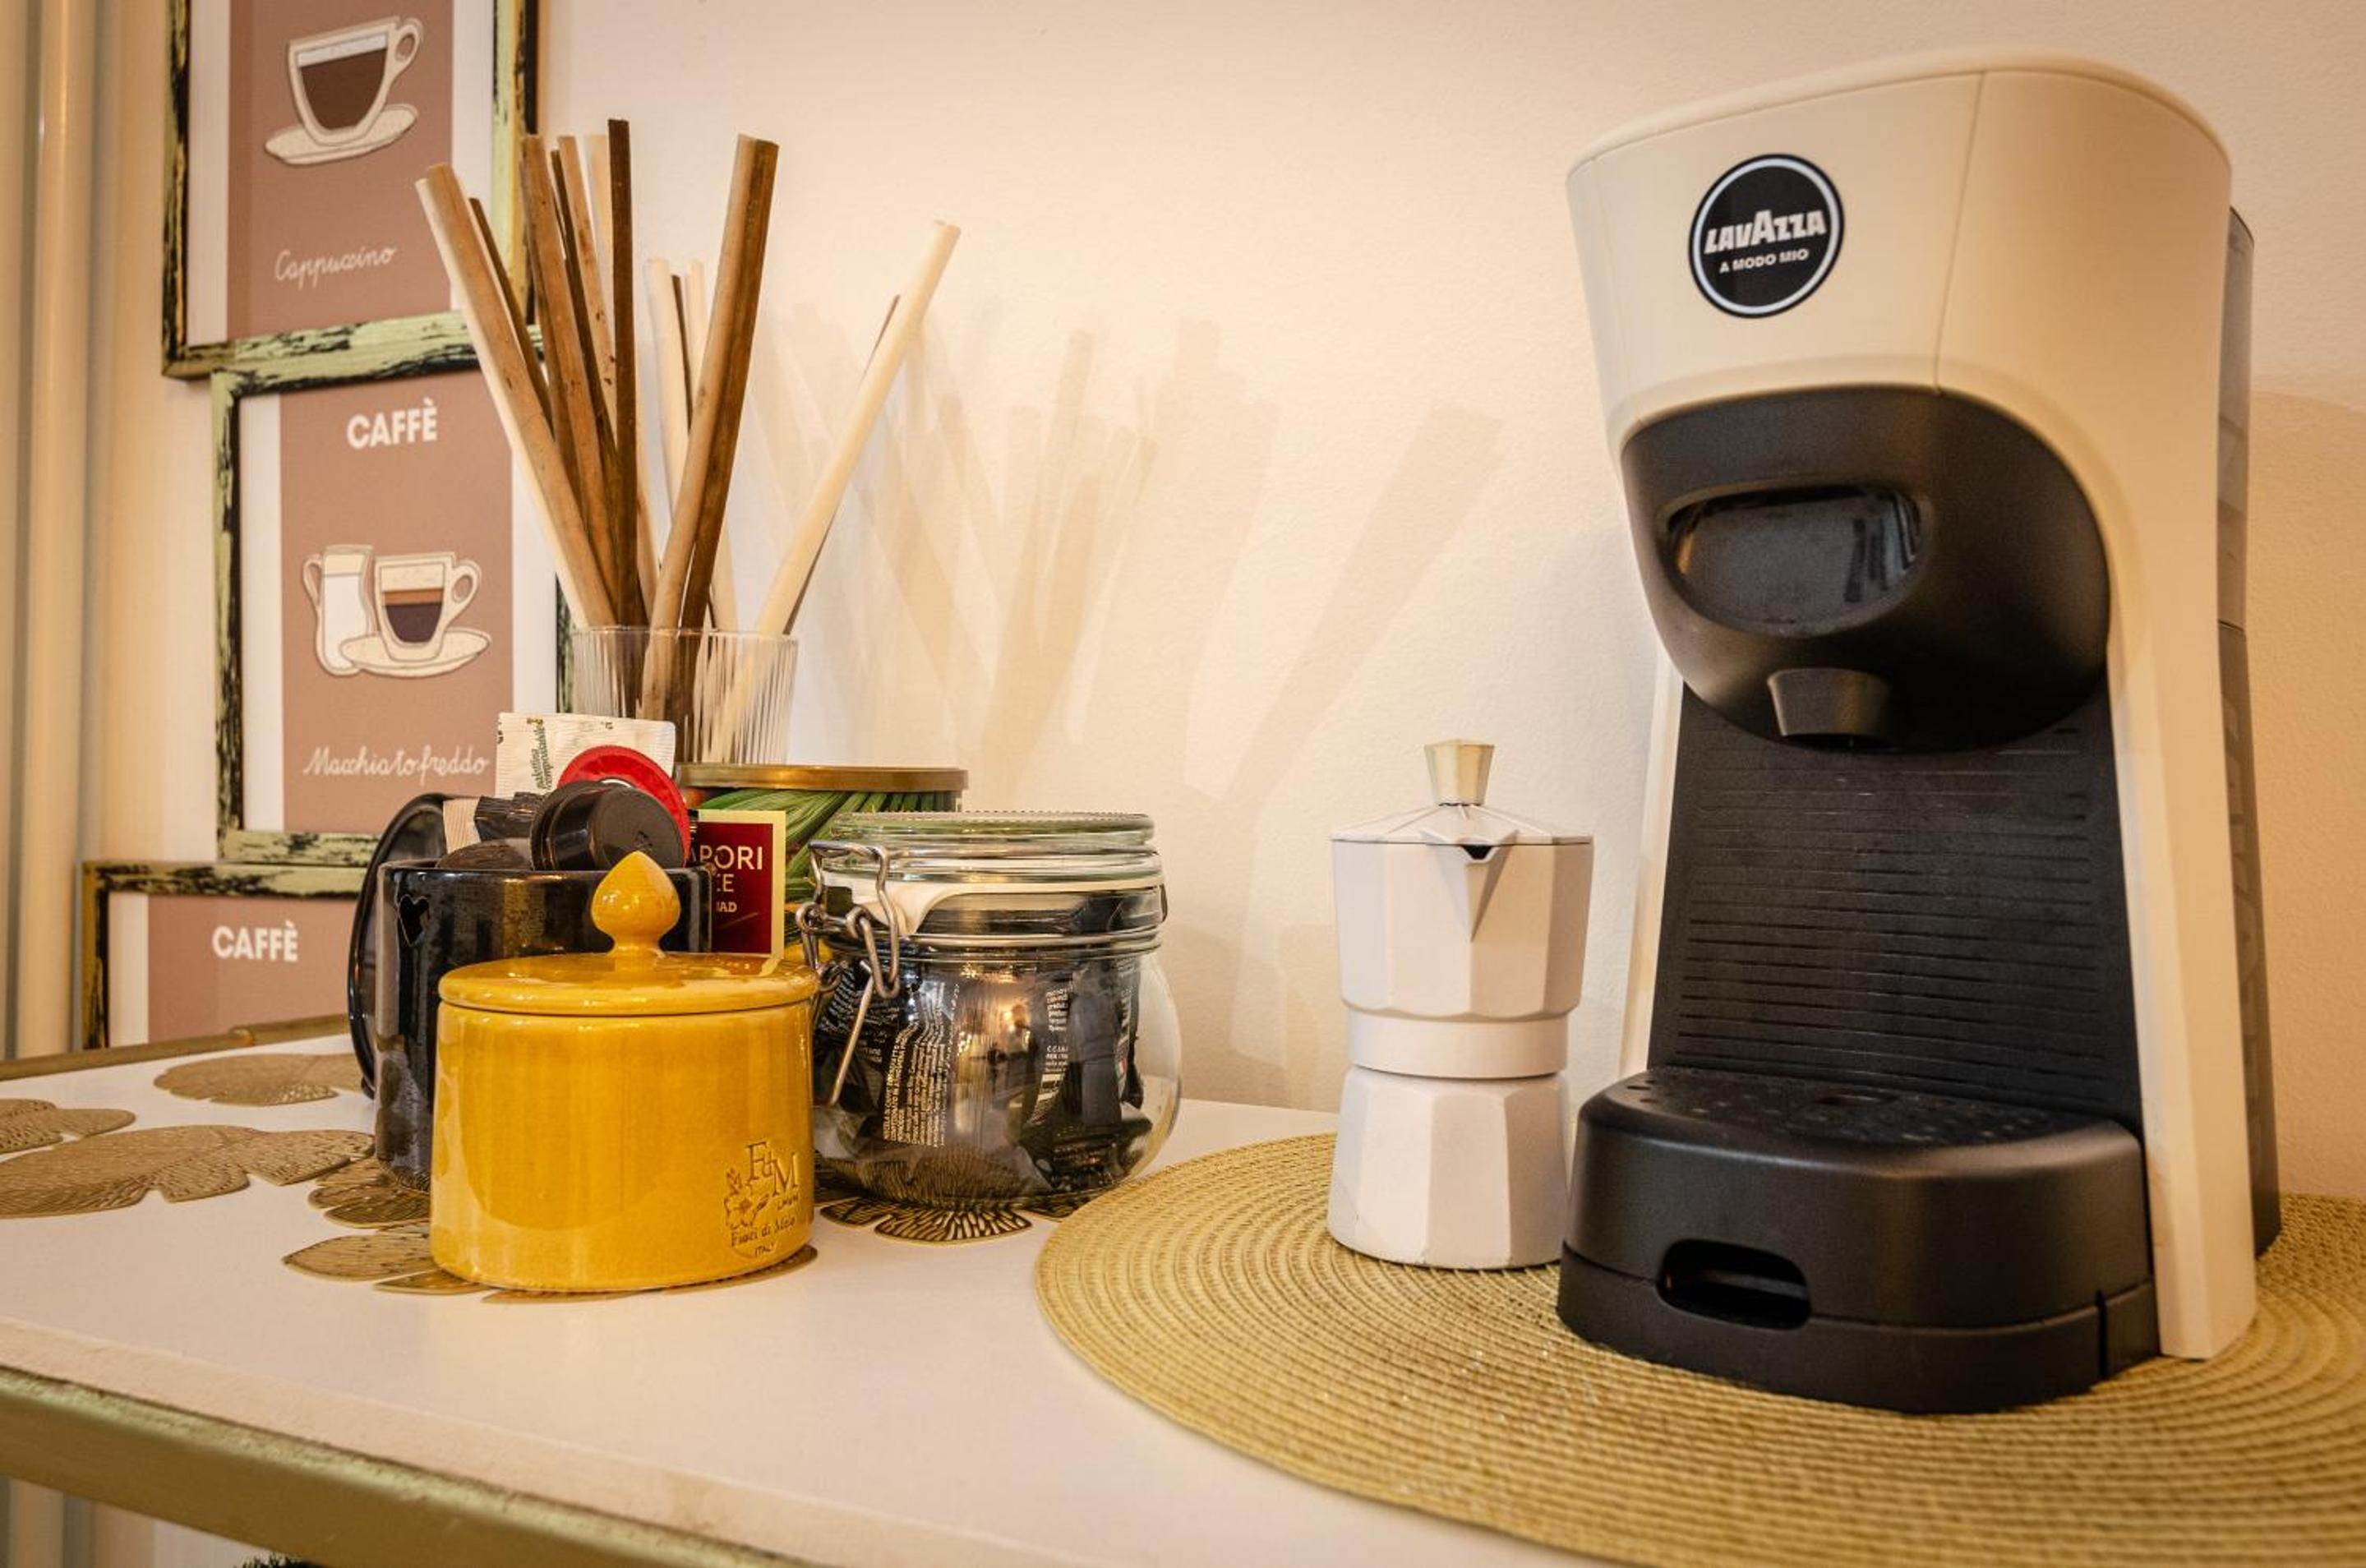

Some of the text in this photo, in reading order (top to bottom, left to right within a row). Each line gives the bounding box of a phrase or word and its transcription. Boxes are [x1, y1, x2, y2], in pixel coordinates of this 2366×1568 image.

[1704, 210, 1827, 256] LAVAZZA
[274, 246, 396, 290] Cappuccino
[1718, 247, 1809, 274] A MODO MIO
[346, 396, 438, 450] CAFFÈ
[302, 745, 488, 787] Macchiato freddo
[690, 843, 763, 870] PORI
[211, 919, 298, 962] CAFFÈ
